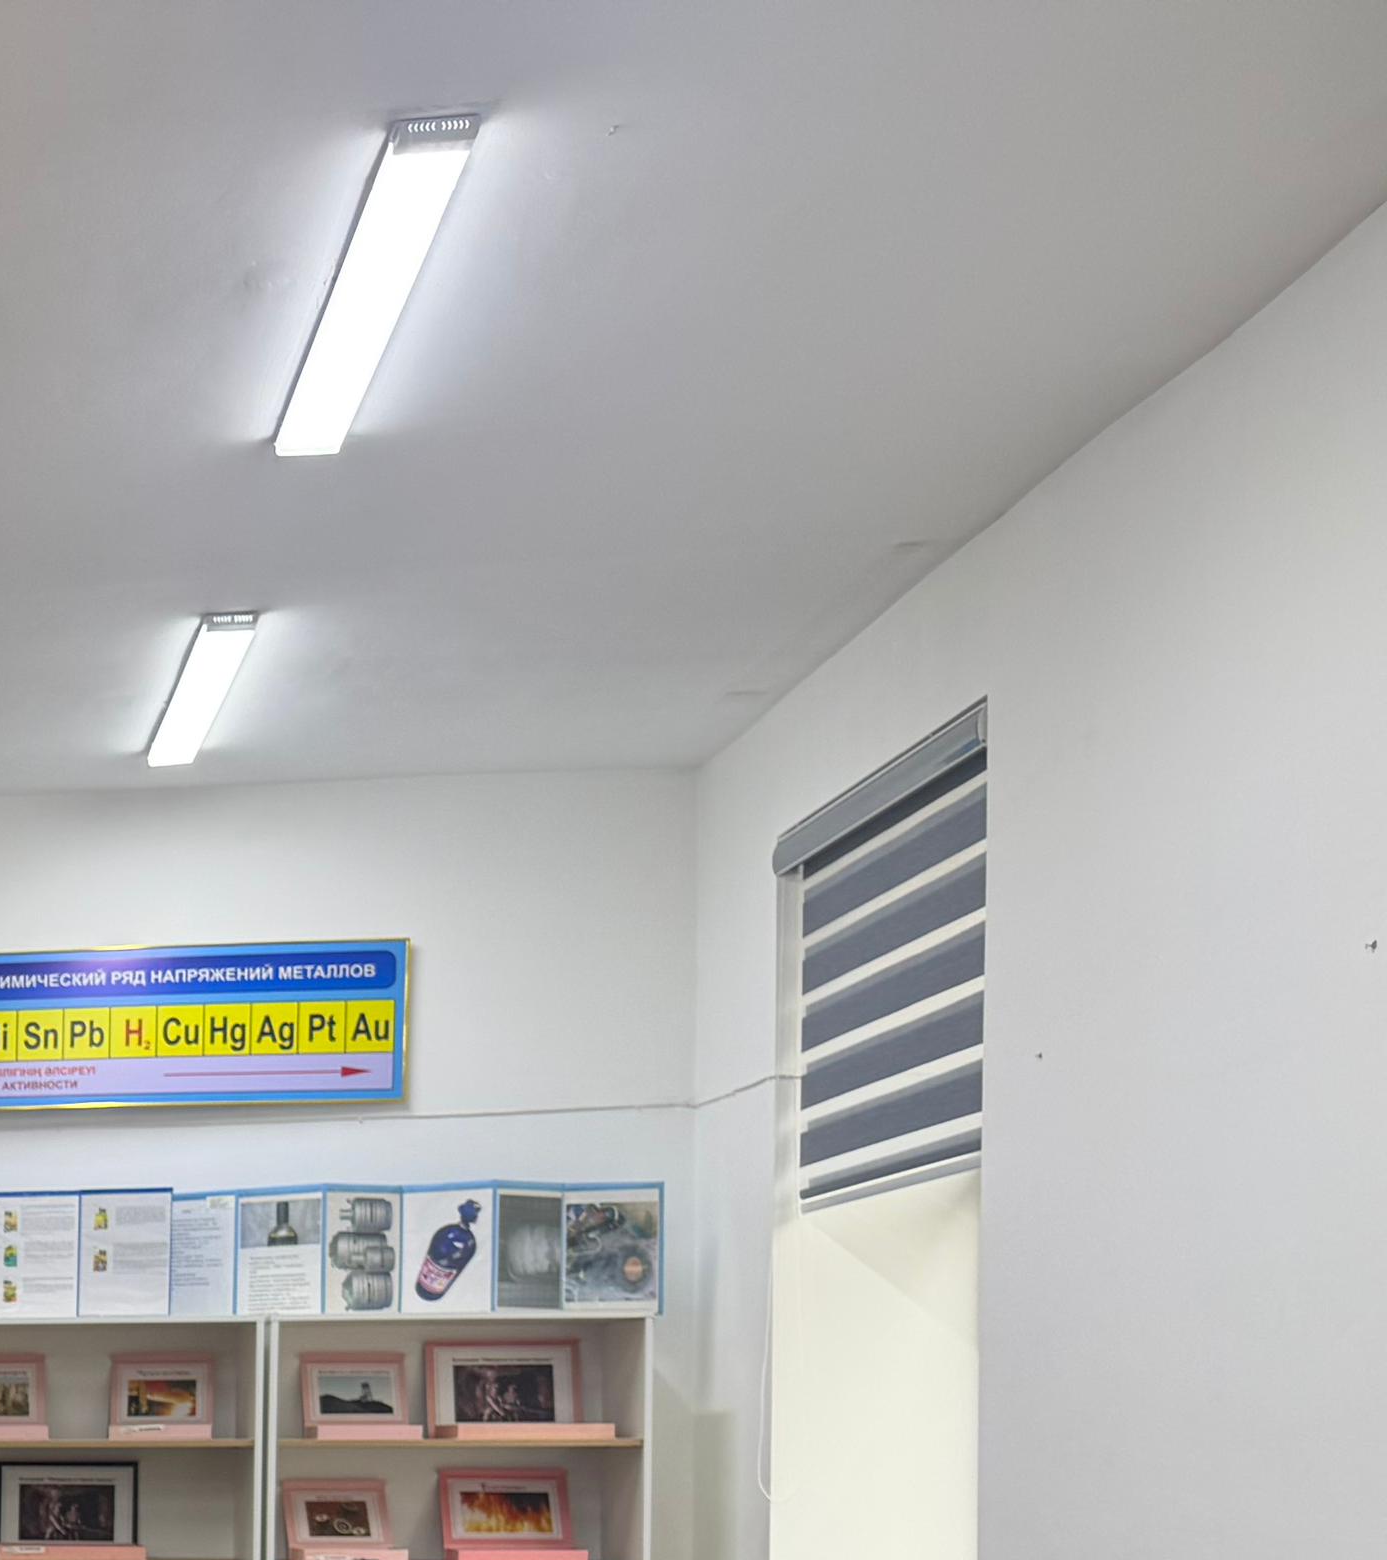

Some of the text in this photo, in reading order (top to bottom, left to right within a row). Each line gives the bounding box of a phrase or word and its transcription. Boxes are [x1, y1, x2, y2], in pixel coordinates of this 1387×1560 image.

[110, 968, 146, 989] РЯД
[149, 962, 274, 985] НАПРЯЖЕНИЙ
[278, 963, 376, 981] МЕТАЛЛОВ
[23, 1021, 59, 1050] Sn
[69, 1019, 105, 1048] Pb
[162, 1017, 200, 1046] Cu
[210, 1016, 247, 1050] Hg
[256, 1015, 295, 1049] Ag
[308, 1014, 336, 1042] Pt
[352, 1013, 391, 1041] Au
[2, 1079, 79, 1092] АКТИВНОСТИ
